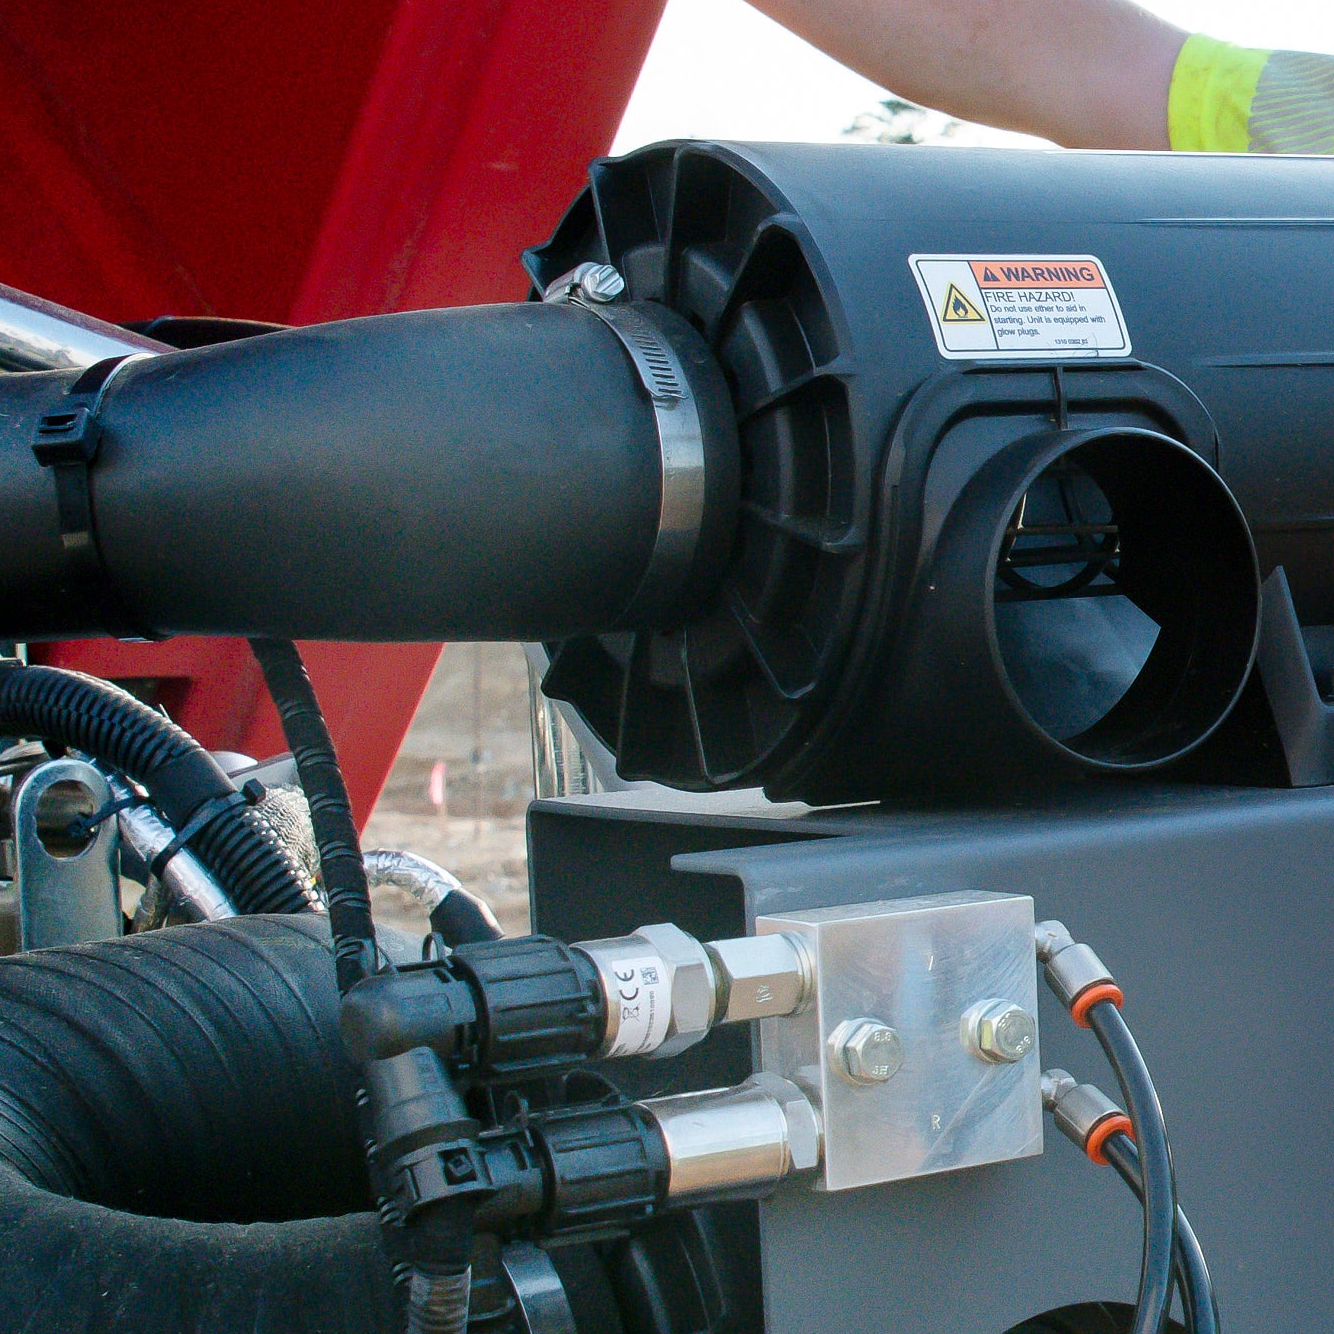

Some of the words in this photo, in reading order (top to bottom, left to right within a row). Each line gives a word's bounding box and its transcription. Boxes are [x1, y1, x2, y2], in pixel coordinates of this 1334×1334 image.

[999, 266, 1095, 282] WARNING
[984, 291, 1016, 303] FIRE
[1018, 291, 1075, 303] HAZARD!
[990, 304, 1003, 313] Do
[1004, 304, 1017, 313] not
[1034, 304, 1055, 313] ether
[1056, 305, 1065, 313] to
[1066, 304, 1078, 313] aid
[1079, 304, 1087, 313] in
[994, 316, 1026, 326] starting.
[1027, 315, 1044, 324] Unit
[1045, 315, 1052, 324] is
[1053, 315, 1089, 326] equipped
[1089, 315, 1106, 324] with
[997, 327, 1017, 337] glow
[1017, 327, 1041, 337] plugs.
